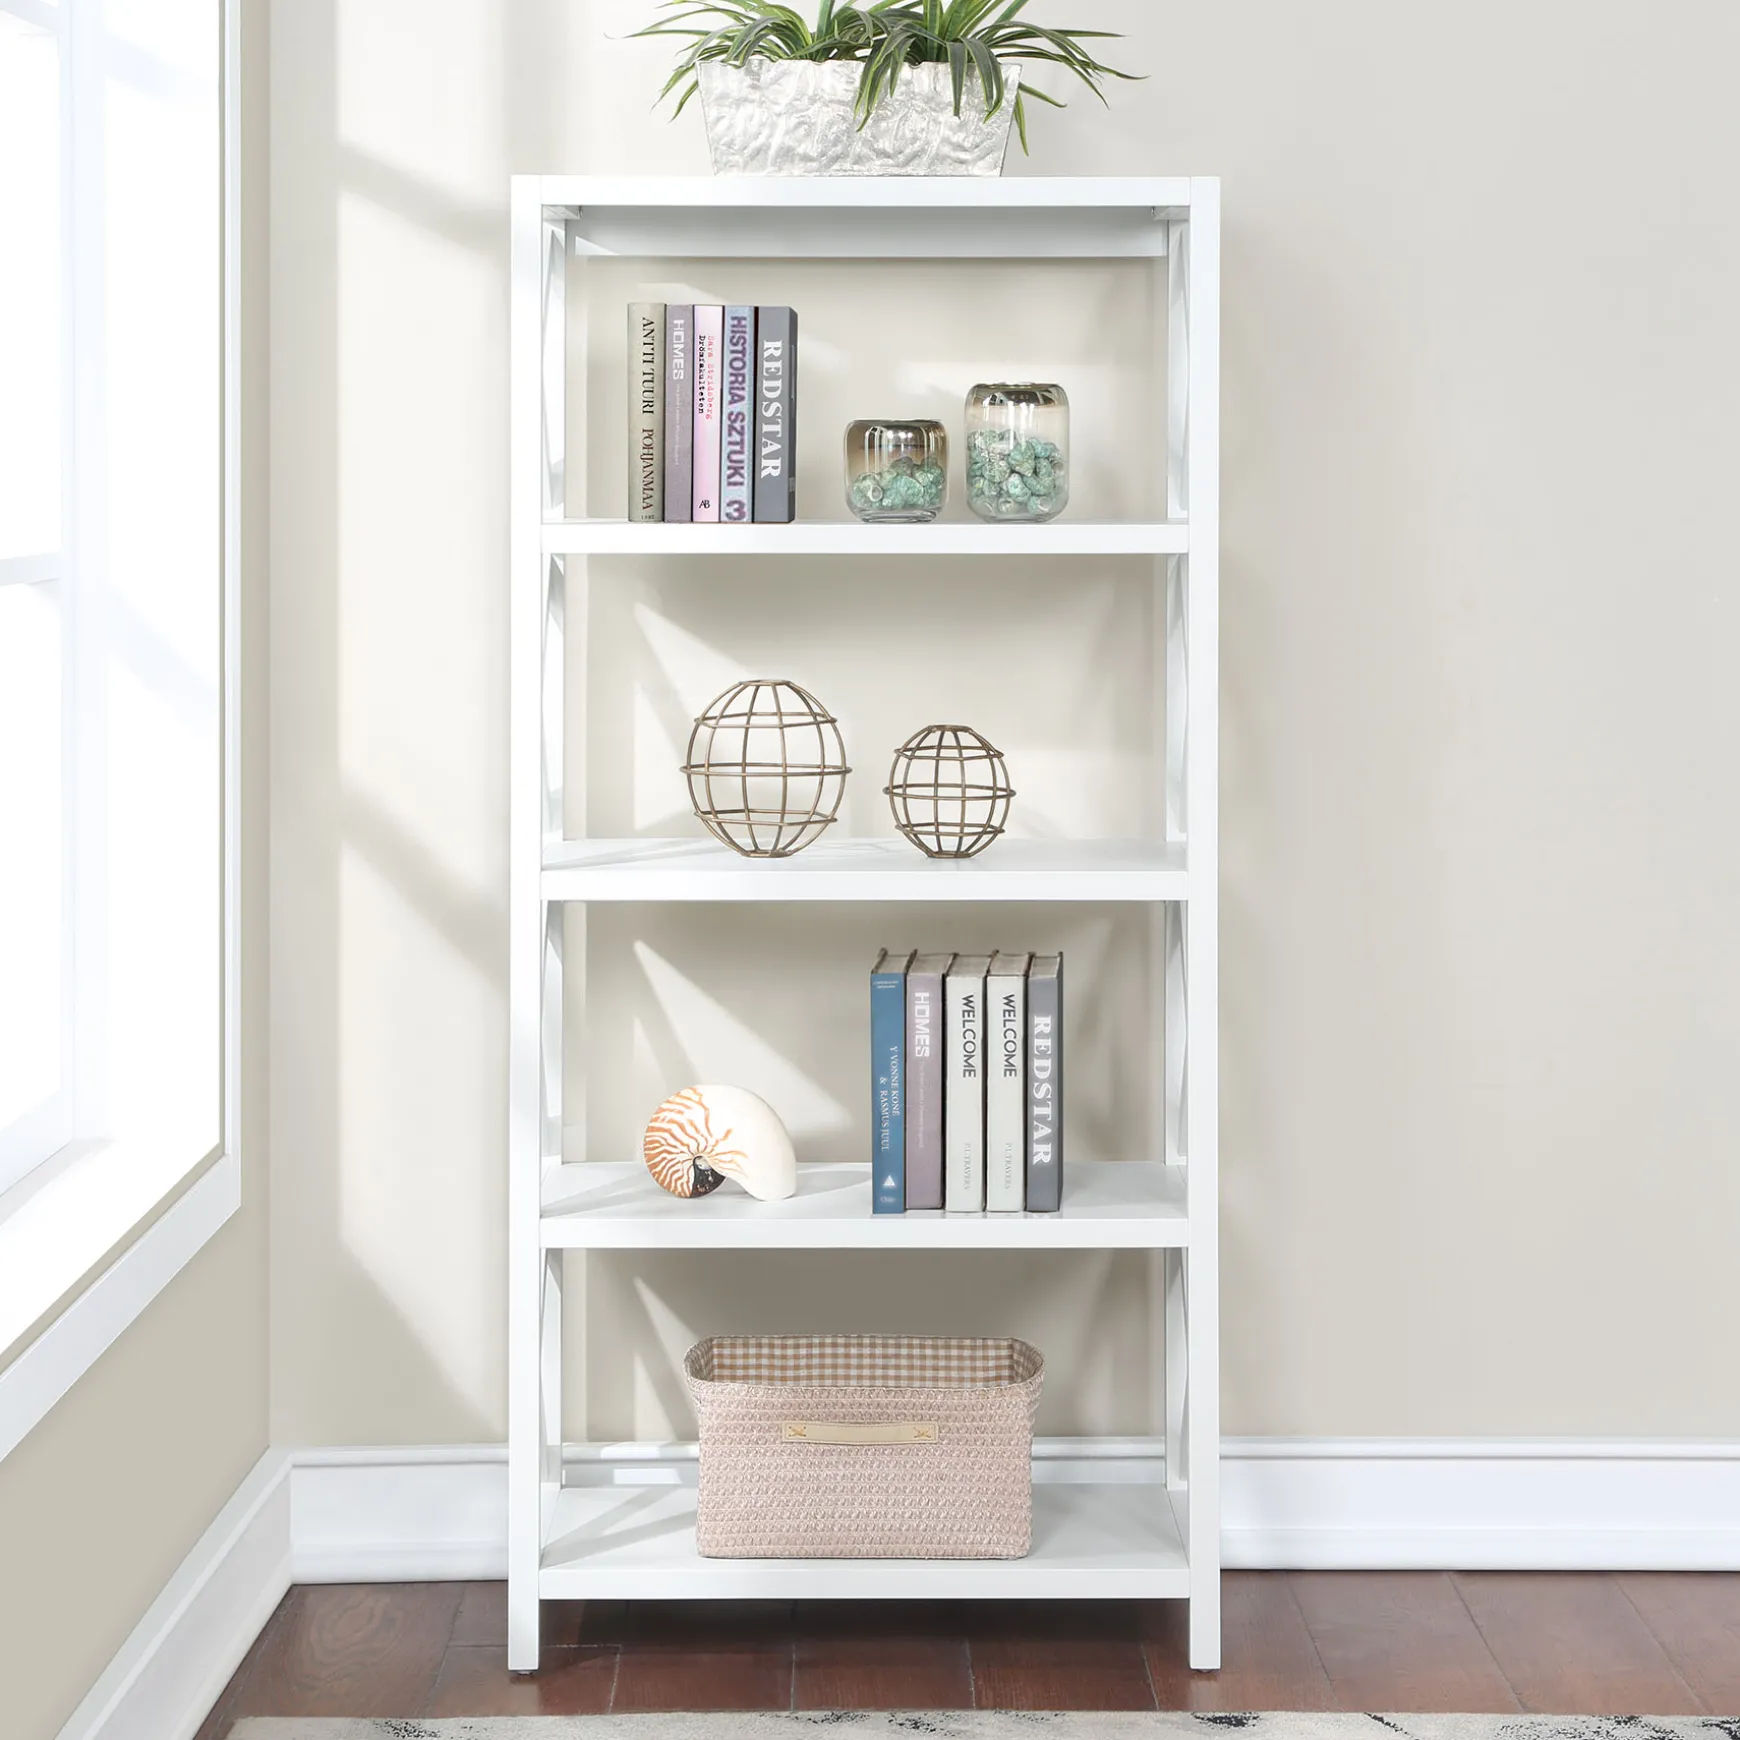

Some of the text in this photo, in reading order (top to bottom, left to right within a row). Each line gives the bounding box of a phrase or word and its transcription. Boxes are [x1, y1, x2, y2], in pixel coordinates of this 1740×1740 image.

[672, 319, 685, 380] HOMES
[640, 317, 655, 510] ANTTI TUURI POHJANMAA
[725, 316, 747, 521] HISTORIA SZTUKI 3
[760, 339, 783, 479] REDSTAR
[914, 992, 930, 1057] HOMES
[962, 994, 976, 1078] WELCOME
[1003, 994, 1017, 1078] WELCOME
[880, 1090, 889, 1127] RASMUS
[1032, 1014, 1052, 1165] REDSTAR
[880, 1129, 889, 1152] JUUL
